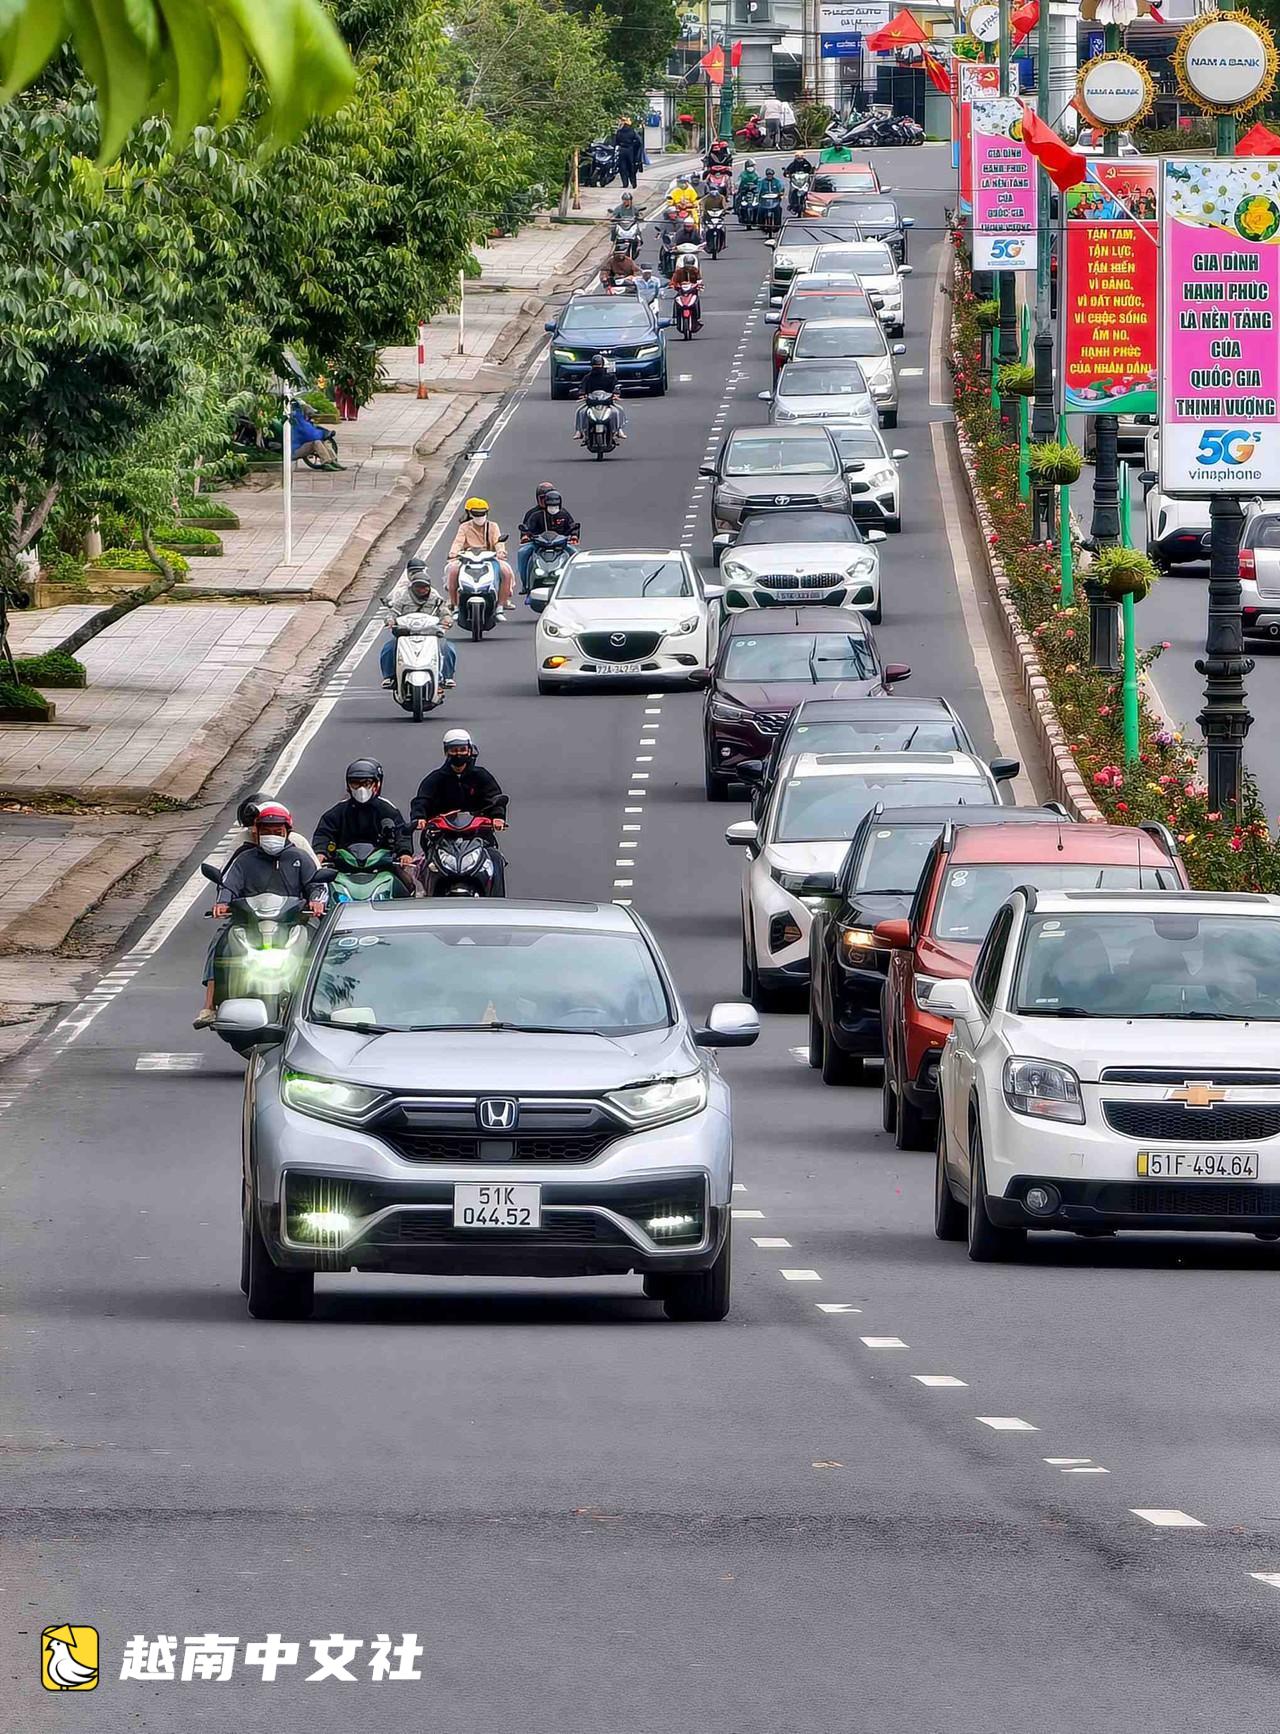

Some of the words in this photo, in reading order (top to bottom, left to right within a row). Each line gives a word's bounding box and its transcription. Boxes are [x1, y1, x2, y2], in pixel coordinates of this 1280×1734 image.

[1191, 58, 1218, 66] NAM
[1229, 59, 1260, 67] BANK
[1192, 253, 1219, 272] GIA
[1183, 282, 1224, 303] HẠNH
[1180, 308, 1198, 330] LÀ
[1201, 306, 1229, 330] NỀN
[1233, 308, 1272, 330] TẢNG
[1210, 337, 1242, 359] CỦA
[1190, 365, 1232, 390] QUỐC
[1235, 369, 1262, 388] GIA
[1176, 398, 1222, 419] THỊNH
[1225, 398, 1276, 420] VƯỢNG
[1151, 1155, 1253, 1176] 51F-494.64
[479, 1187, 515, 1206] 51K
[462, 1207, 531, 1227] 044.52
